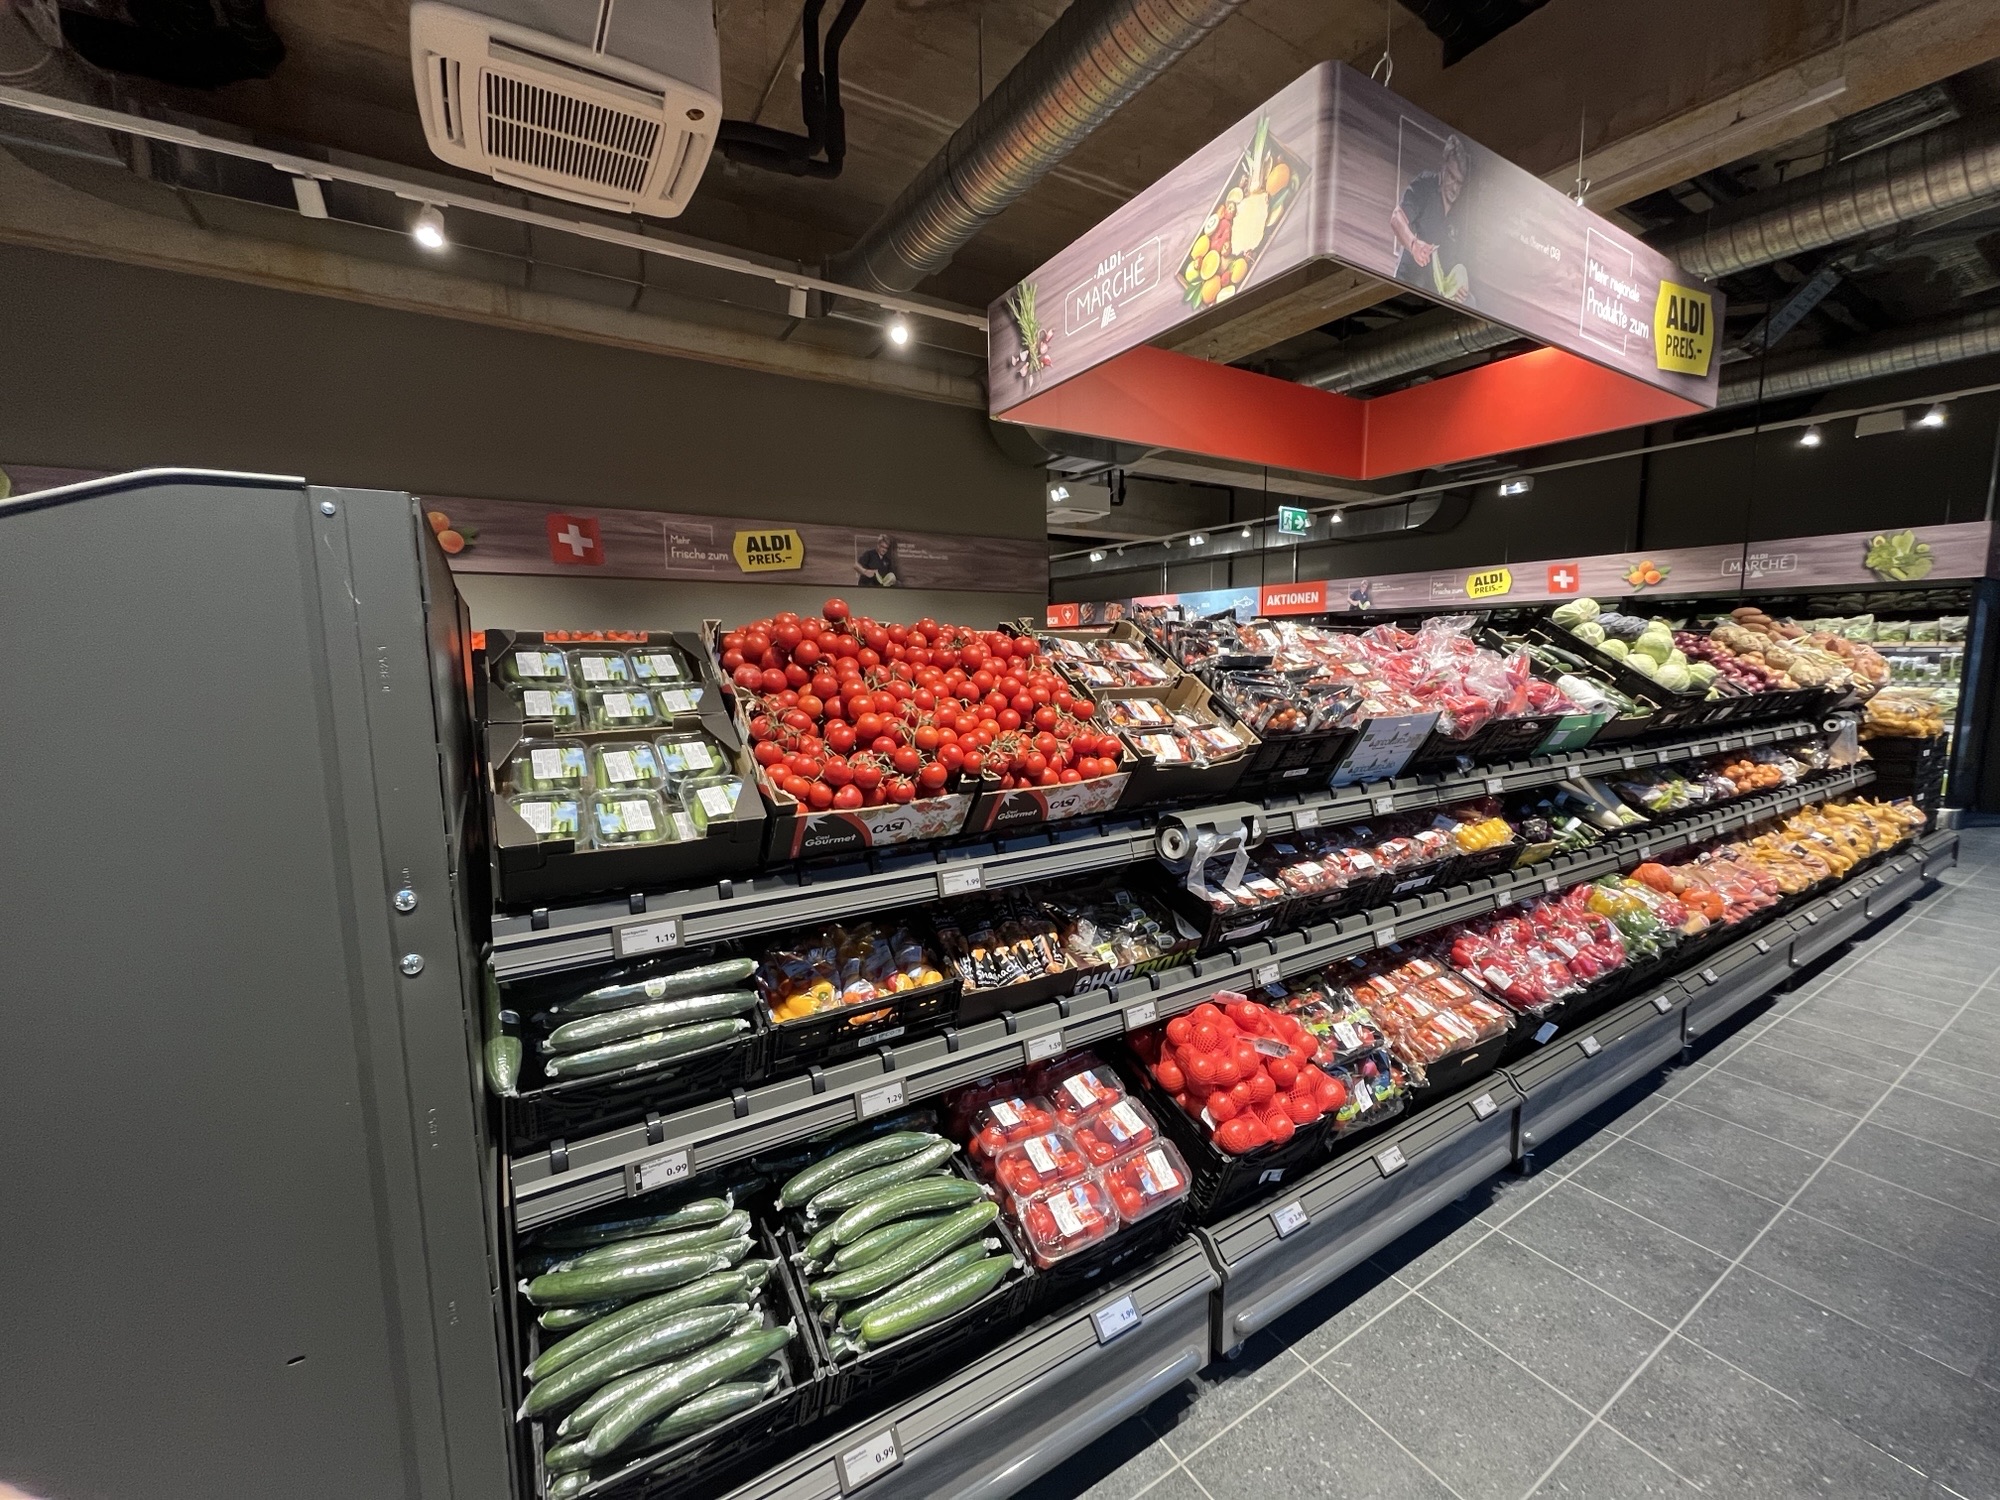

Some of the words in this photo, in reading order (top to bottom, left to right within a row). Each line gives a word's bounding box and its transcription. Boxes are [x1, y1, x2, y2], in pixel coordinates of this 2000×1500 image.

[1097, 250, 1121, 279] ALDI
[1076, 253, 1146, 321] MARCHÉ
[1589, 258, 1610, 287] Mehr
[1610, 279, 1640, 303] regionale
[1586, 286, 1628, 329] Produkte
[1629, 317, 1649, 339] zum
[1666, 294, 1706, 336] ALDI
[670, 534, 691, 545] Mehr
[746, 534, 792, 553] ALDI
[671, 546, 706, 560] Frische
[707, 551, 729, 561] zum
[1749, 553, 1769, 561] ALDI
[1729, 555, 1789, 572] MARCHÉ
[1474, 572, 1503, 587] ALDI
[1266, 591, 1319, 606] AKTIONEN
[1050, 798, 1076, 809] CASI
[997, 809, 1038, 820] Gourmet
[872, 821, 905, 834] CASI
[805, 833, 857, 847] Gourmet
[655, 932, 676, 943] 1.19
[887, 1092, 903, 1104] 1.29
[666, 1163, 687, 1176] 0.99
[1121, 1308, 1135, 1321] 1.99
[875, 1445, 894, 1463] 0.99
